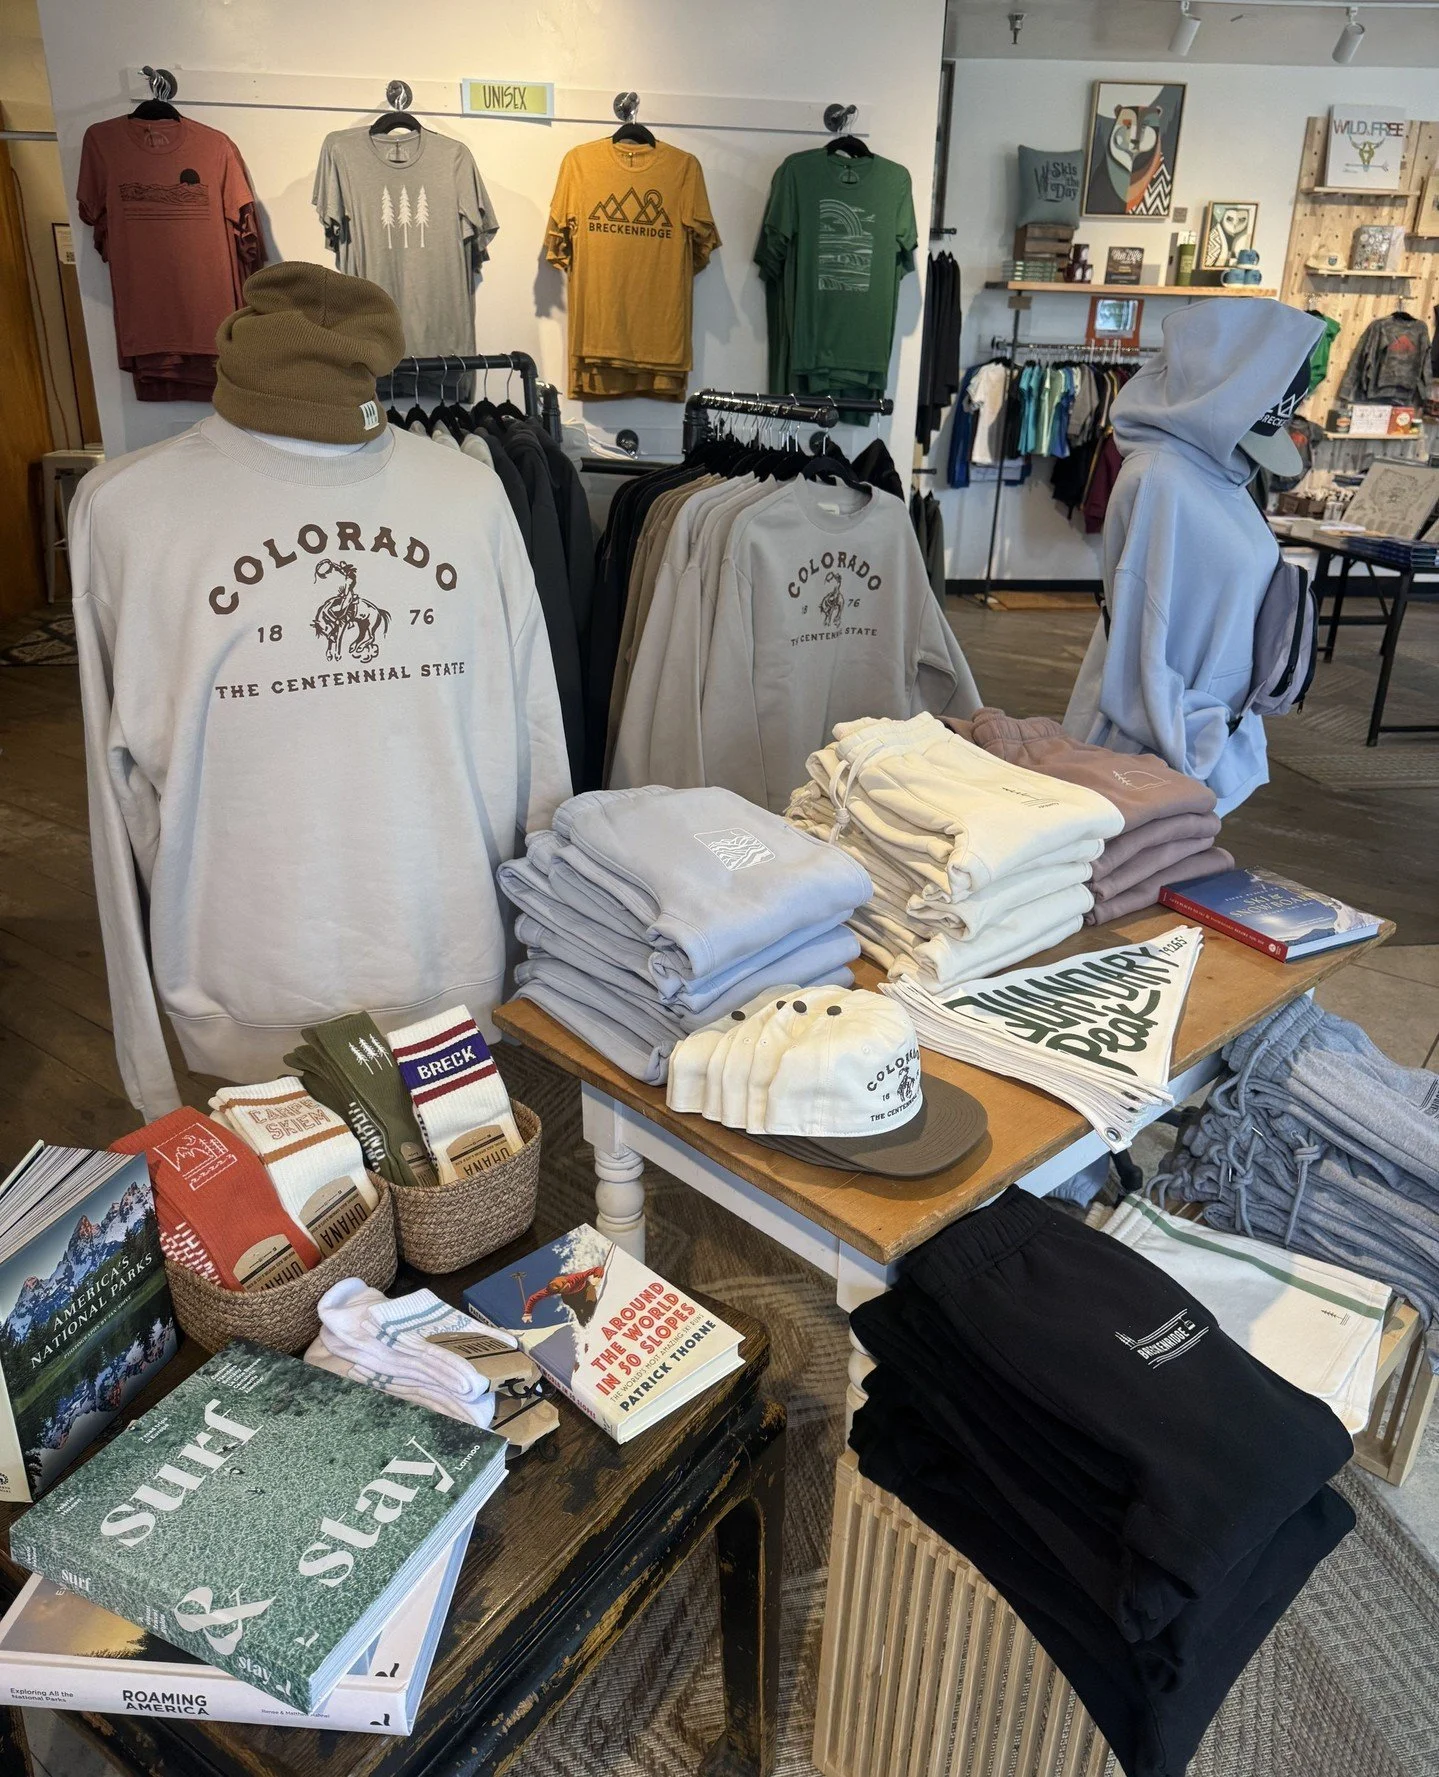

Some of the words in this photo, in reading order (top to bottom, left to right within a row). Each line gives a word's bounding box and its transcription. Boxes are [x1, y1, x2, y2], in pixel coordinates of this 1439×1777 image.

[483, 85, 527, 110] UNISEX
[1333, 120, 1367, 135] WILD
[1371, 121, 1404, 137] FREE
[1051, 161, 1078, 178] Skis
[1066, 176, 1080, 187] the
[1051, 183, 1079, 201] Day
[588, 222, 672, 239] BRECKENRIDGE
[208, 521, 459, 616] COLORADO
[788, 551, 882, 598] COLORADO
[847, 598, 861, 608] 76
[409, 608, 435, 626] 76
[257, 624, 283, 645] 18
[845, 627, 877, 637] STATE
[215, 683, 259, 700] THE
[271, 664, 412, 695] CENTENNIAL
[420, 661, 466, 679] STATE
[1230, 893, 1315, 918] SNOWBOAR
[1243, 895, 1269, 906] SKI
[942, 946, 1180, 1045] QUANDARY
[1046, 989, 1161, 1077] Peak
[416, 1045, 477, 1081] BRECK
[249, 1099, 320, 1124] CARPE
[265, 1109, 331, 1140] SKIEM
[870, 1112, 886, 1122] THE
[319, 1202, 368, 1249] OHANA
[53, 1255, 130, 1331] AMERICA'S
[30, 1295, 108, 1370] NATIONAL
[112, 1252, 153, 1297] PARKS
[601, 1280, 665, 1340] AROUND
[590, 1341, 626, 1371] THE
[622, 1291, 680, 1341] WORLD
[453, 1340, 507, 1354] OHANA
[595, 1372, 621, 1396] IN
[618, 1350, 642, 1375] 50
[639, 1301, 696, 1354] SLOPES
[610, 1390, 623, 1402] THE
[621, 1368, 647, 1392] WORLD'S
[645, 1353, 661, 1369] MOST
[660, 1332, 684, 1355] AMAZING
[683, 1325, 692, 1334] SKI
[690, 1313, 704, 1326] RUNS
[619, 1362, 672, 1411] PATRICK
[670, 1319, 716, 1362] THORNE
[454, 1444, 480, 1470] Lannoo
[100, 1399, 264, 1548] surf
[300, 1436, 455, 1588] stay
[61, 1569, 92, 1592] surf
[173, 1583, 275, 1656] &
[238, 1656, 273, 1683] stay
[10, 1687, 47, 1697] Exploring
[122, 1689, 208, 1707] ROAMING
[126, 1702, 210, 1716] AMERICA
